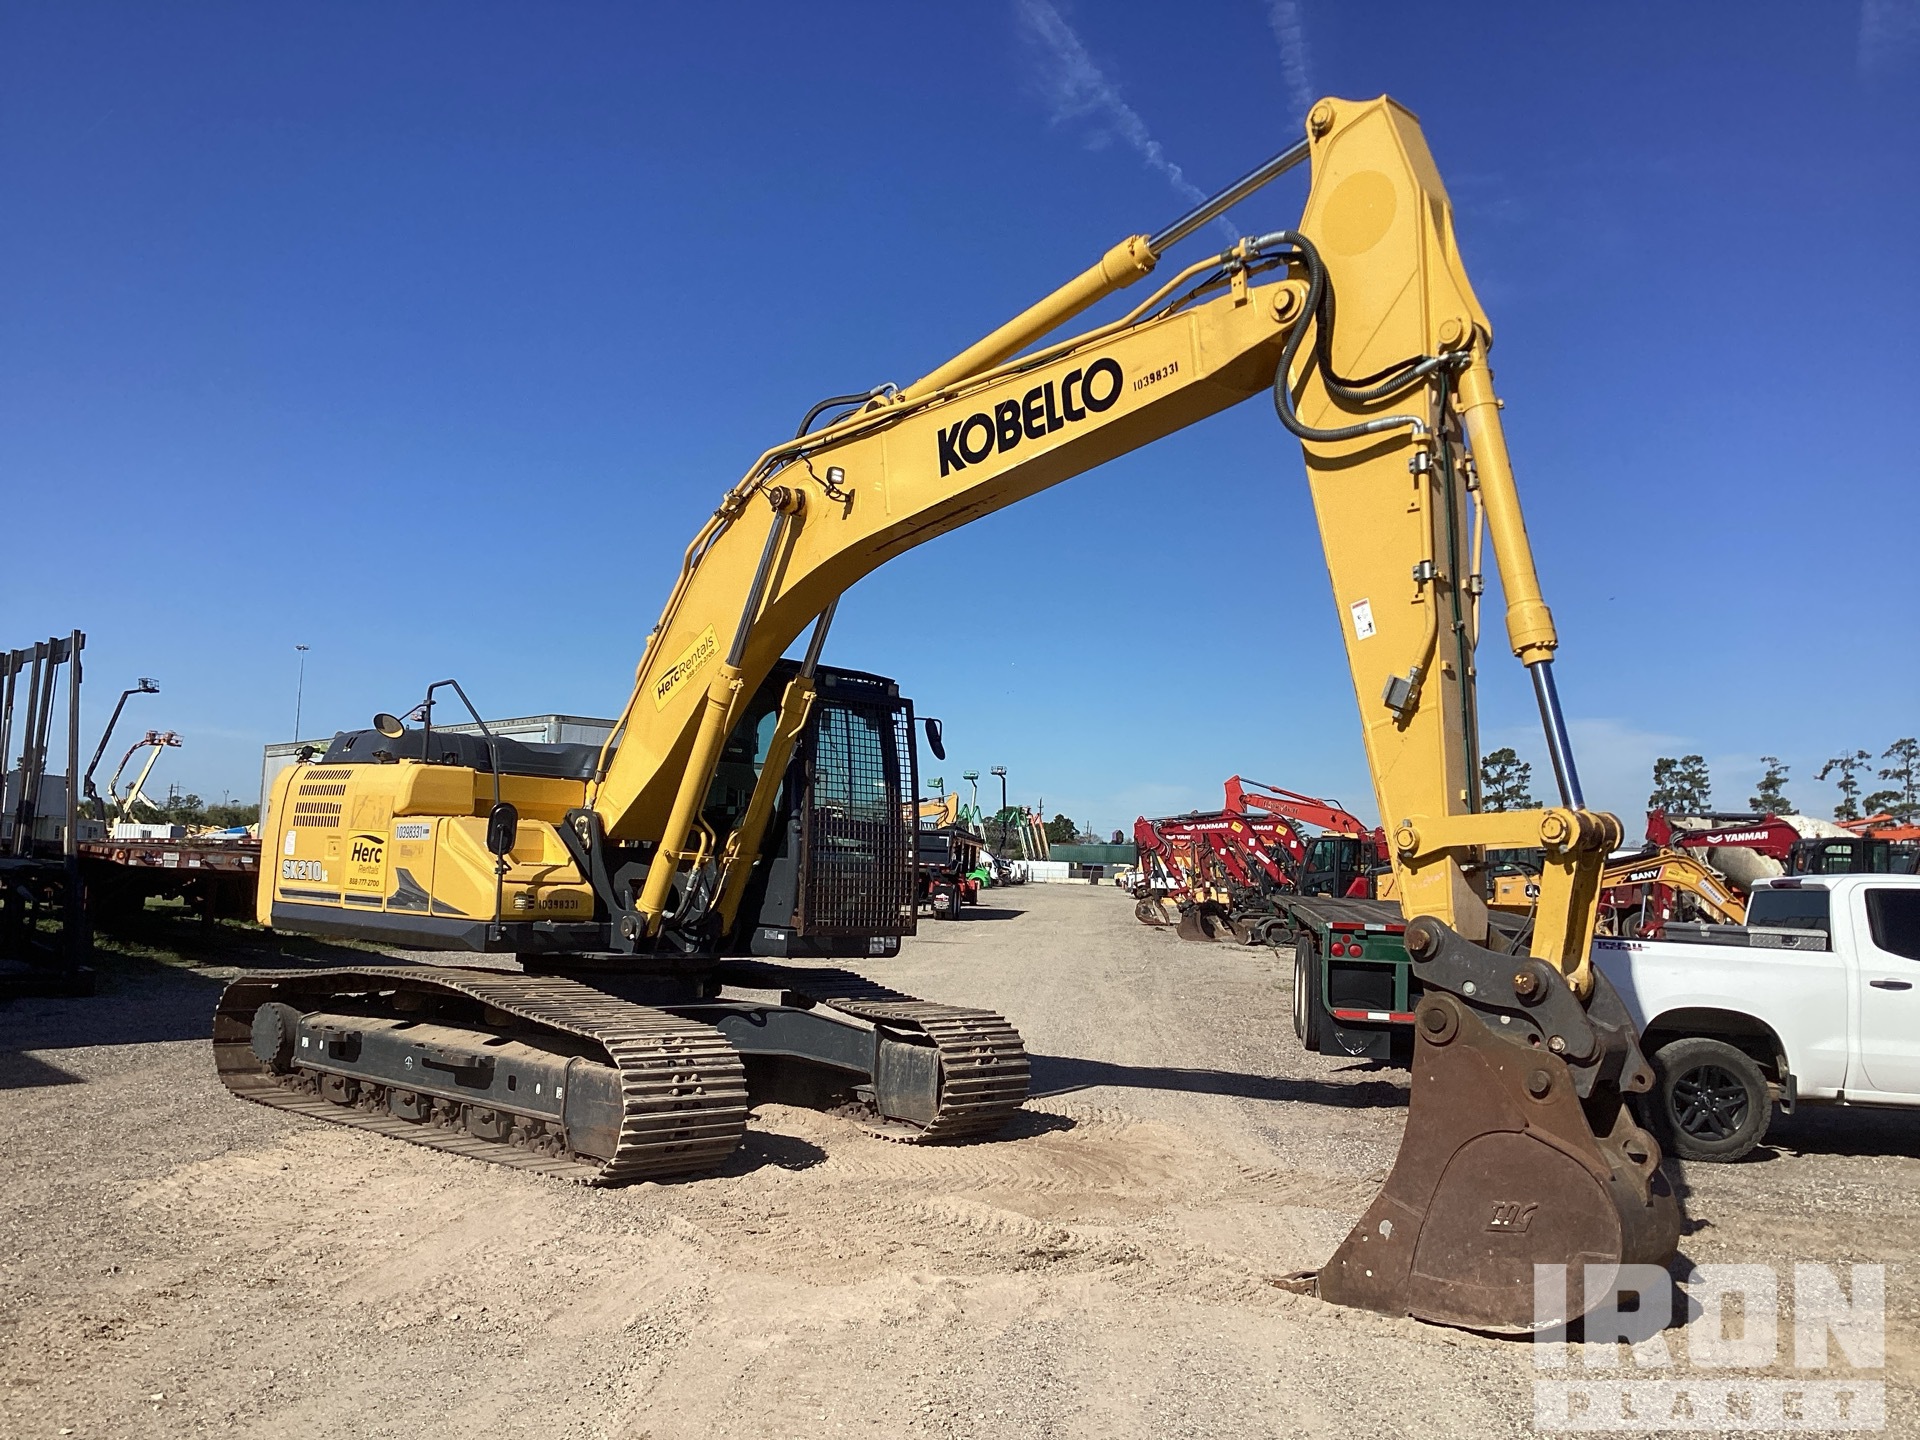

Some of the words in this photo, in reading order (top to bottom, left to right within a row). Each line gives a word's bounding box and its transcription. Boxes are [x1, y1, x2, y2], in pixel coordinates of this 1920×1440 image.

[1133, 361, 1179, 391] 10398331
[937, 357, 1123, 478] KOBELCO
[1196, 822, 1229, 830] YANMAR
[1724, 831, 1769, 842] YANMAR
[351, 842, 383, 864] Herc
[358, 864, 380, 875] Rentals
[1630, 870, 1658, 881] SANY
